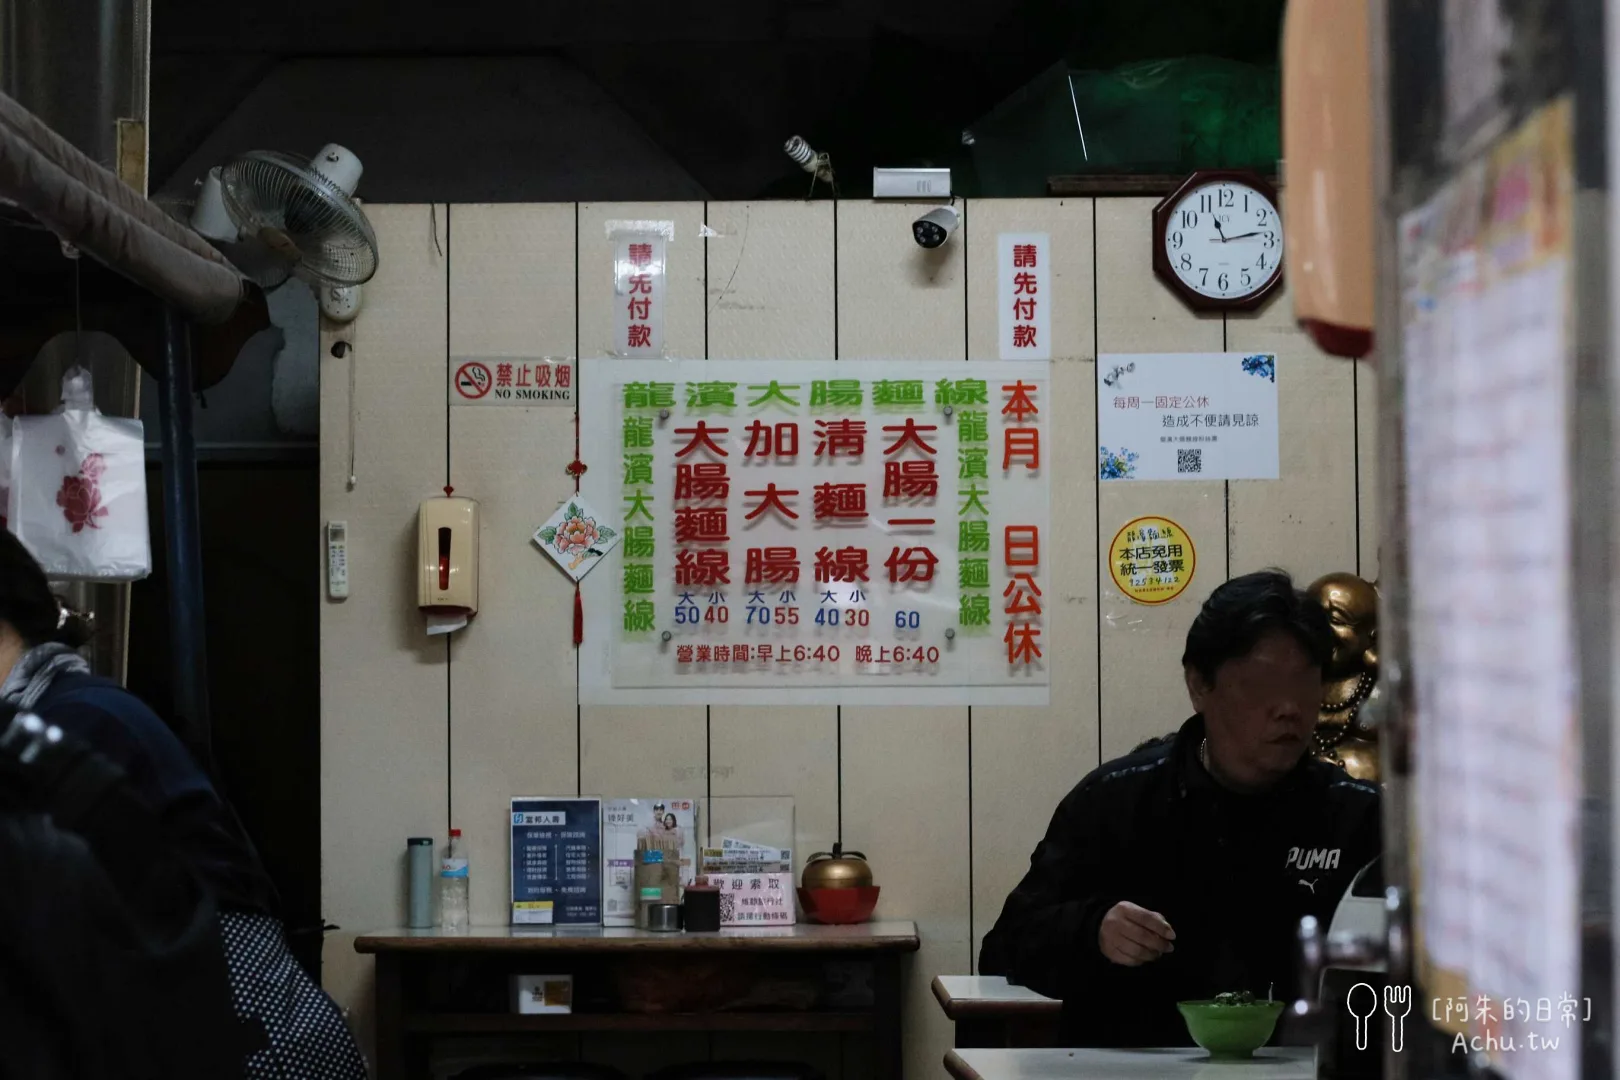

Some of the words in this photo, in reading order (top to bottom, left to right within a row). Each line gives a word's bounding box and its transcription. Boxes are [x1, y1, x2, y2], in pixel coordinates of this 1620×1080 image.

[1200, 194, 1212, 213] 11
[1218, 189, 1234, 208] 12
[1181, 210, 1198, 229] 10
[1256, 208, 1267, 227] 2
[1172, 231, 1183, 249] 9
[1263, 231, 1275, 249] 3
[1180, 253, 1192, 271] 8
[1255, 252, 1267, 270] 4
[1199, 268, 1209, 286] 7
[1218, 273, 1229, 291] 6
[1240, 268, 1251, 286] 5
[627, 243, 653, 348] 請先付款
[1012, 244, 1038, 348] 請先付款
[496, 362, 571, 388] 禁止吸烟
[495, 389, 511, 399] NO
[515, 389, 570, 400] SMOKING
[622, 378, 989, 408] 龍濱大腸麵線
[1113, 395, 1210, 410] 每周一固定公休
[1001, 380, 1039, 470] 本月
[1162, 413, 1260, 428] 造成不便請見諒
[674, 420, 731, 586] 大腸麵線
[744, 419, 801, 584] 加大腸
[813, 419, 869, 584] 清麵線
[882, 418, 939, 584] 大腸一份
[622, 416, 656, 633] 龍濱大腸麵線
[957, 410, 992, 627] 龍濱大腸麵線
[1119, 544, 1183, 560] 本店免用
[1120, 559, 1184, 576] 統一發票
[678, 590, 696, 604] 大
[709, 590, 725, 604] 小
[748, 590, 765, 604] 大
[779, 590, 796, 604] 小
[820, 590, 837, 604] 大
[849, 589, 866, 604] 小
[1002, 525, 1042, 664] 日公休
[674, 607, 700, 626] 50
[704, 607, 729, 625] 40
[745, 607, 770, 626] 70
[774, 607, 800, 626] 55
[814, 608, 839, 627] 40
[844, 608, 870, 627] 30
[895, 610, 920, 629] 60
[855, 644, 940, 664] 晚上6:40
[1286, 846, 1341, 870] PUMA
